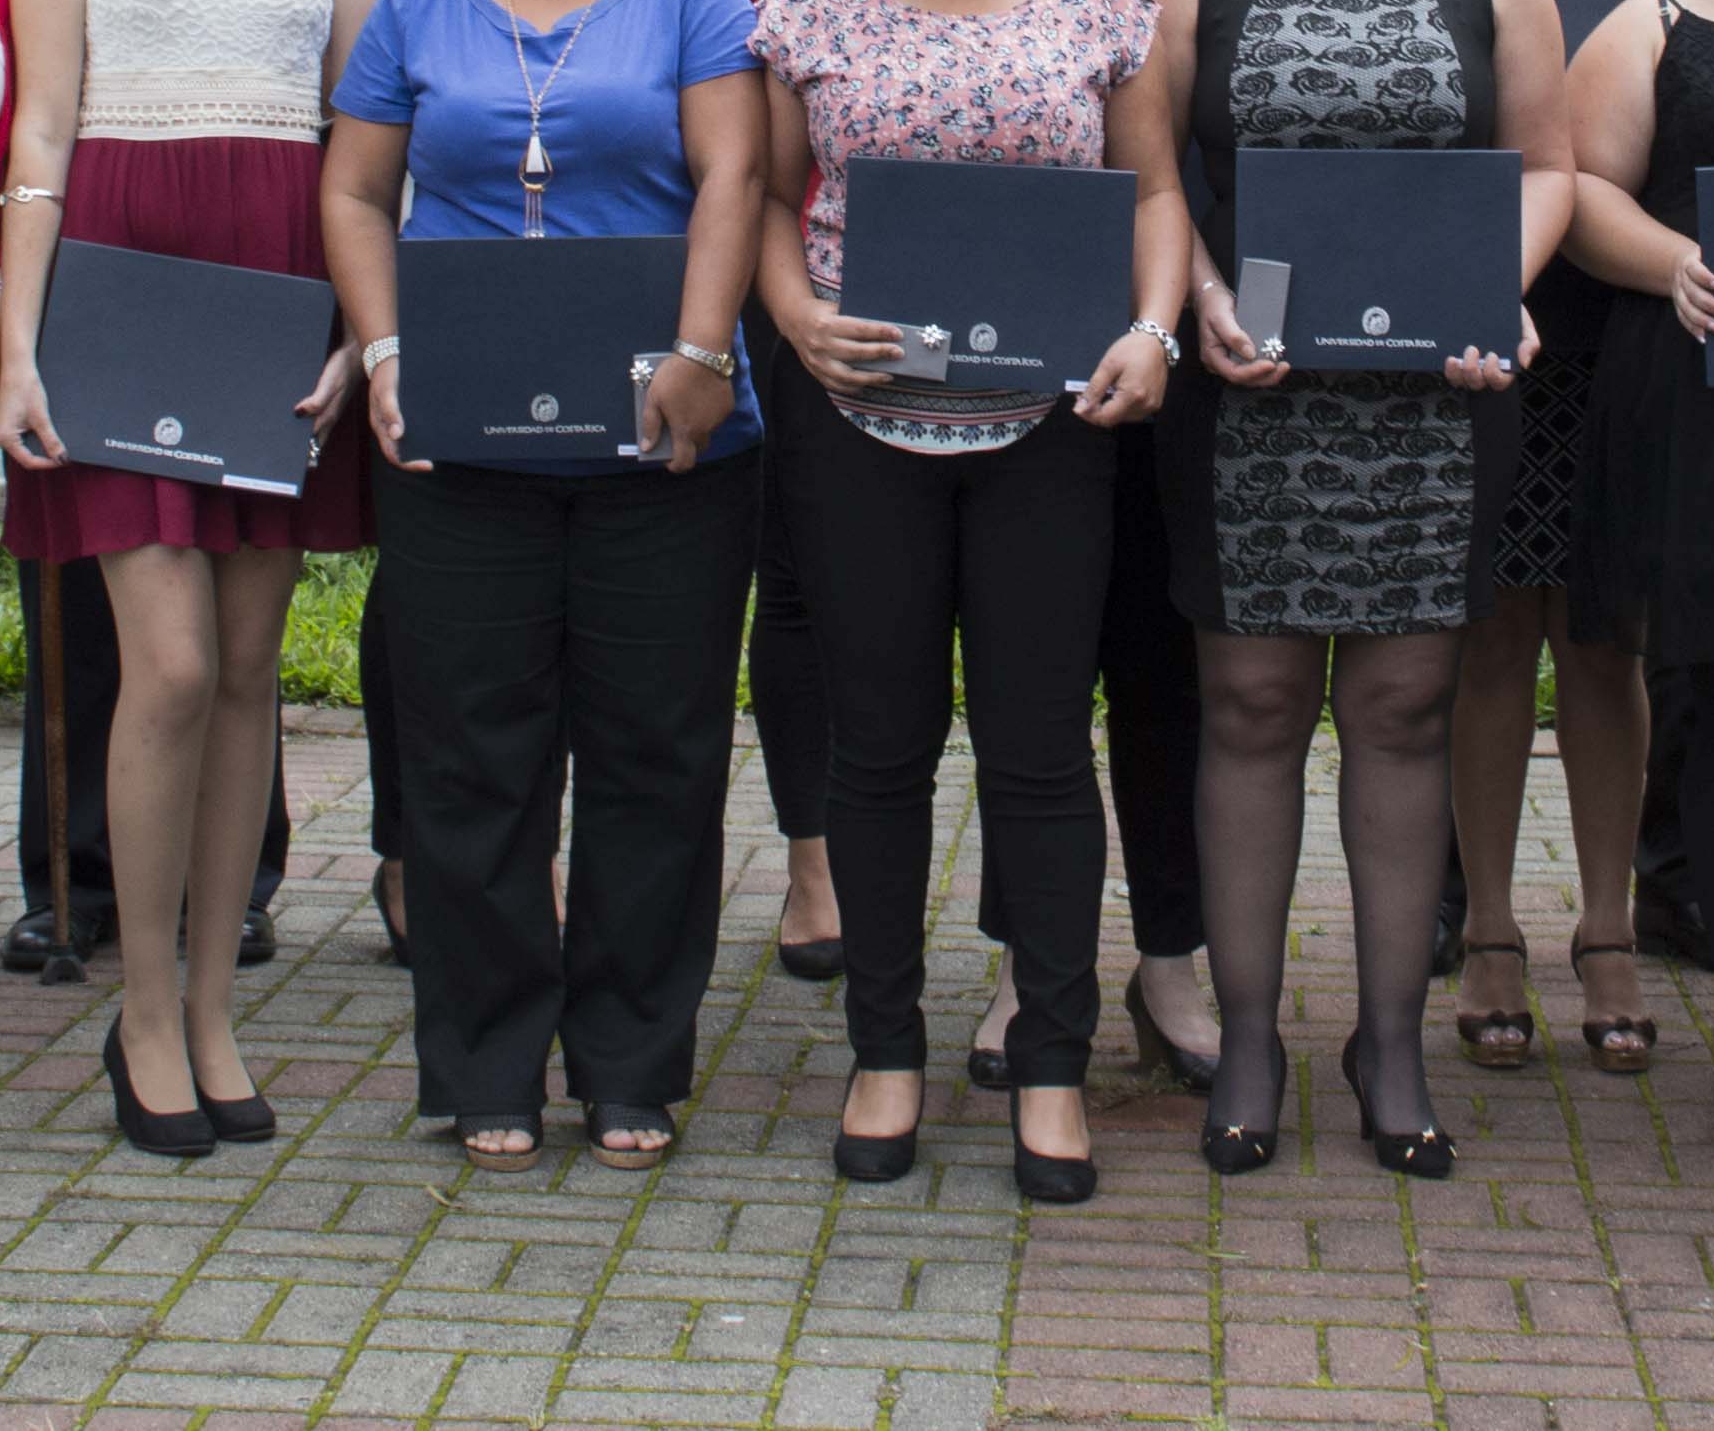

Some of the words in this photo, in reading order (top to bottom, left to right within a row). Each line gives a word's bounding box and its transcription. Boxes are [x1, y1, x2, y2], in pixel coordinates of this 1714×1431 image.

[1315, 337, 1374, 347] UNIVERSIDAD
[1386, 338, 1414, 348] COSTA
[1414, 339, 1437, 349] RICA
[992, 356, 1021, 366] COSTA
[1021, 357, 1045, 368] RICA
[484, 426, 544, 435] UNIVERSIDAD
[555, 425, 584, 434] COSTA
[584, 424, 607, 434] RICA
[105, 438, 163, 456] UNIVERSIDAD
[173, 450, 202, 462] COSTA
[202, 454, 225, 466] RICA
